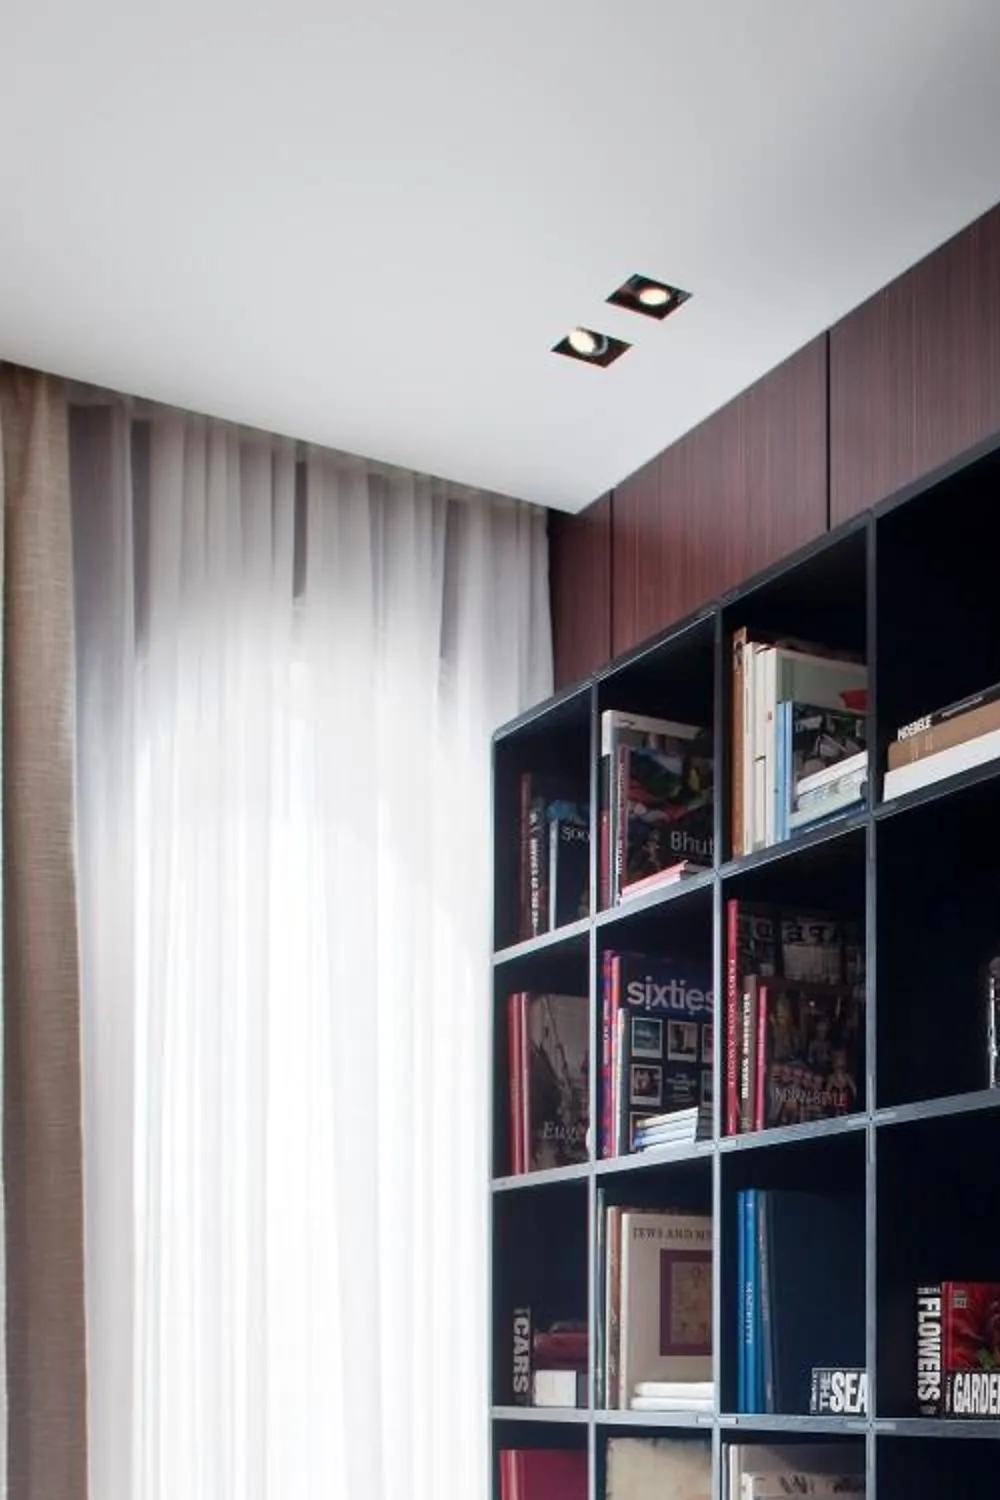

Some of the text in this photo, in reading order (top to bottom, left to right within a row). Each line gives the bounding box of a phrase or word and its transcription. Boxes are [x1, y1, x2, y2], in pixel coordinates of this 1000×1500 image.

[627, 975, 715, 1016] sixties
[512, 1317, 531, 1394] CARS
[917, 1296, 941, 1401] FLOWERS
